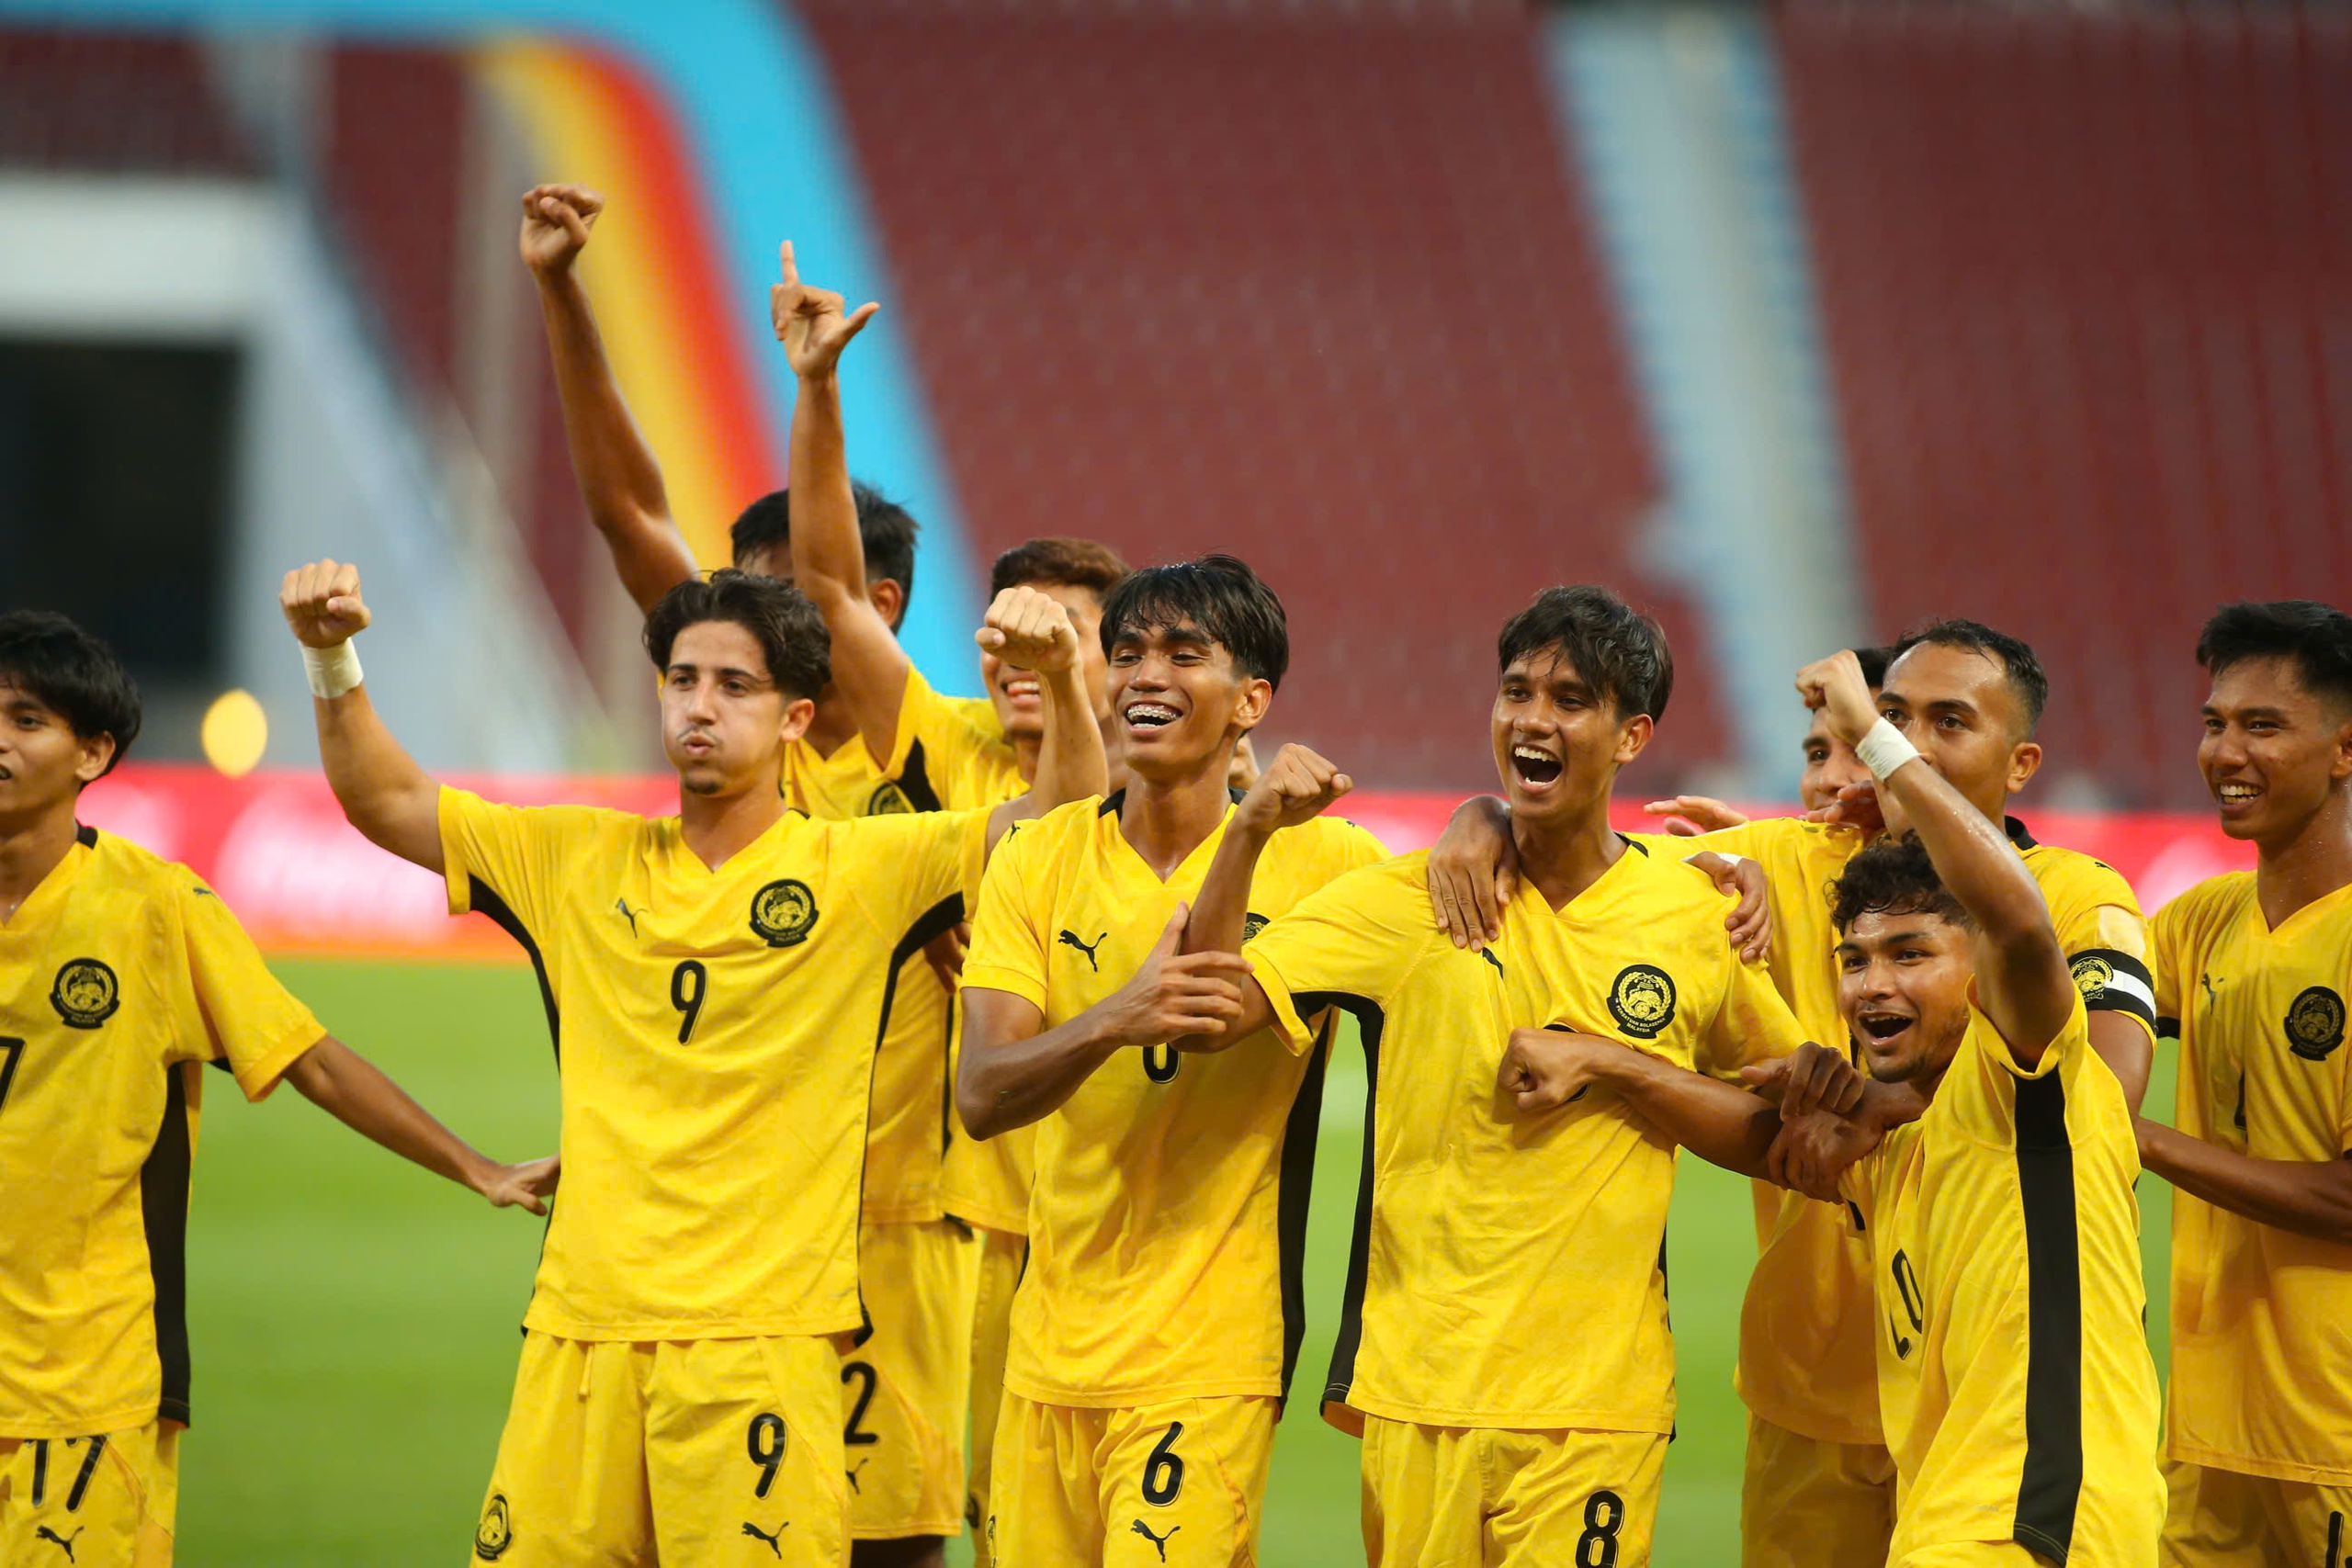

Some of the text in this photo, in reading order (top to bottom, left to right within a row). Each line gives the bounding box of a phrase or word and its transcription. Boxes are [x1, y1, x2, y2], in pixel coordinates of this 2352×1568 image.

[671, 959, 708, 1045] 9
[24, 1434, 110, 1513] 17
[748, 1412, 788, 1500] 9
[1142, 1421, 1185, 1507] 6
[1576, 1490, 1625, 1568] 8
